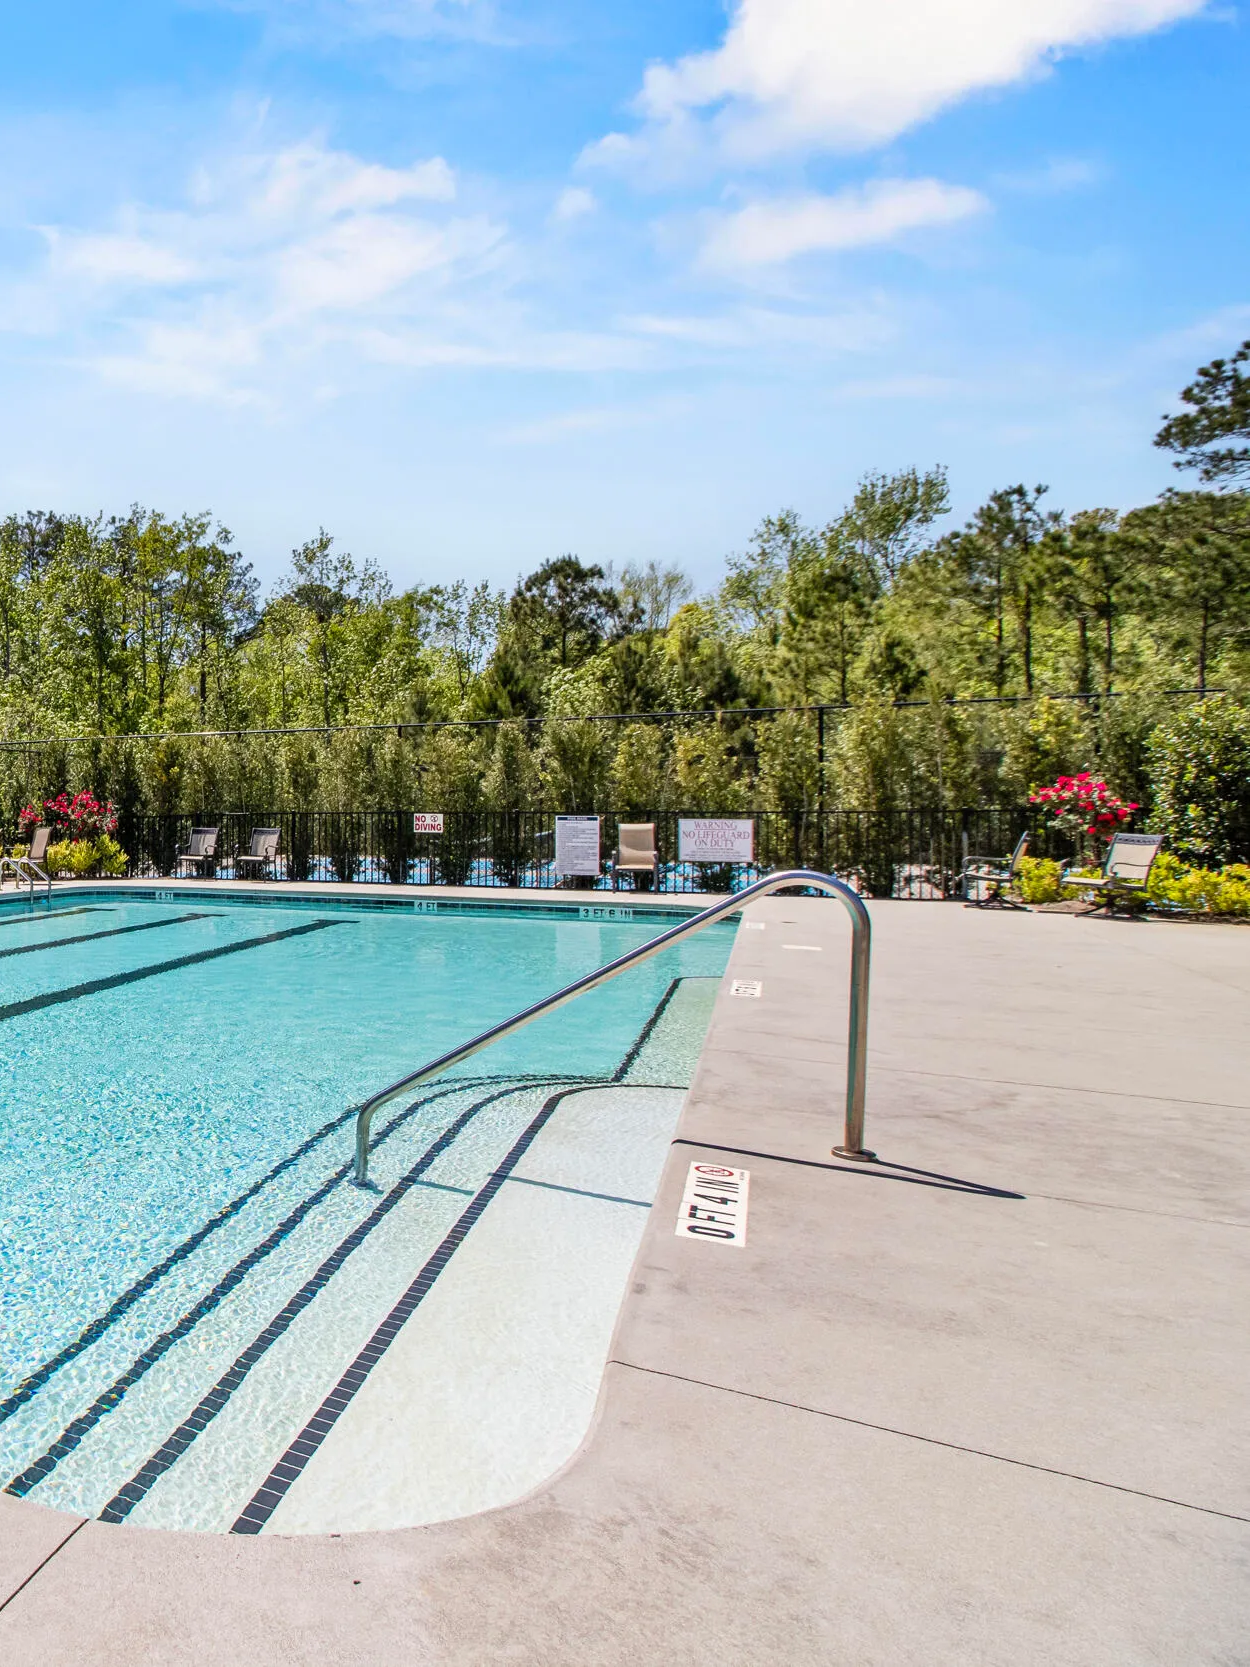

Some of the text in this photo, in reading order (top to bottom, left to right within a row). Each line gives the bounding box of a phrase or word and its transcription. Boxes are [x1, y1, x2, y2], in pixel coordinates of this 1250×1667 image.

[414, 815, 427, 823] NO
[415, 823, 442, 831] DIVING
[694, 821, 737, 830] WARNING
[682, 830, 750, 840] NO LIFEGUARD
[694, 839, 734, 848] ON DUTY
[694, 1176, 740, 1194] IN
[693, 1193, 738, 1206] 4
[688, 1204, 736, 1226] FT
